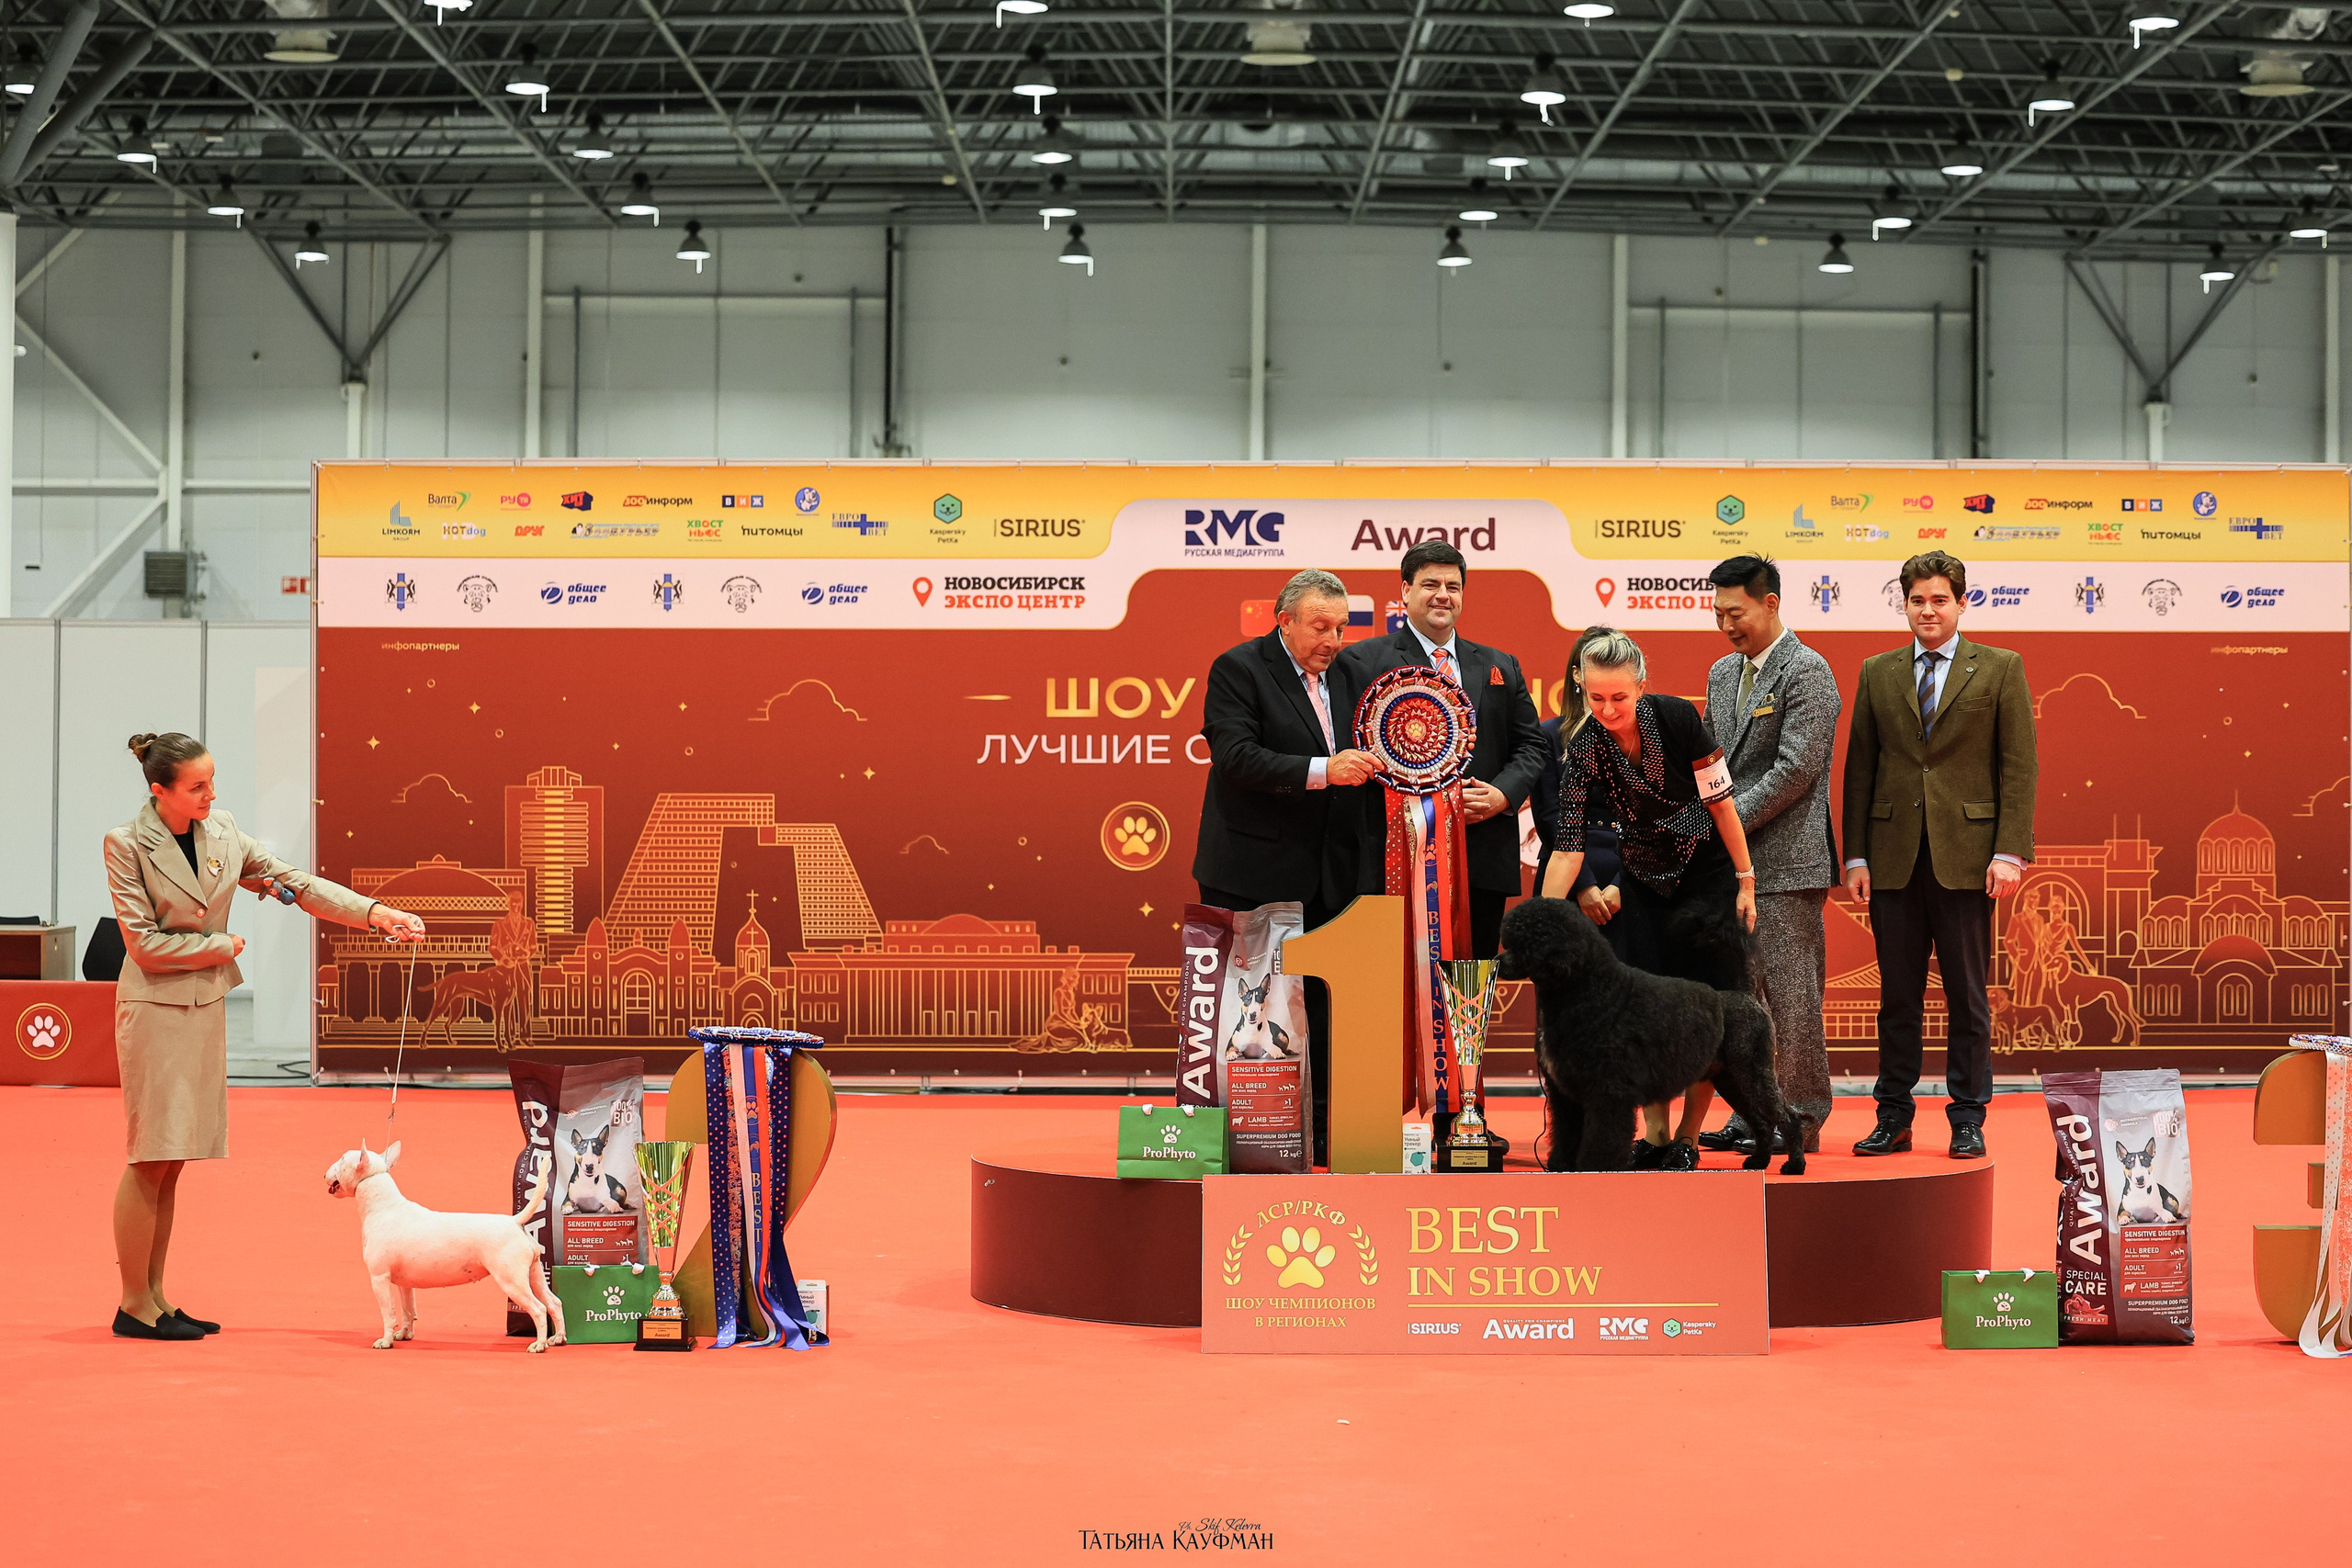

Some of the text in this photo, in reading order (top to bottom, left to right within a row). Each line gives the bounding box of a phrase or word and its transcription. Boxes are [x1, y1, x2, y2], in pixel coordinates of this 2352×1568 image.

[428, 493, 457, 504] Валта
[686, 520, 724, 528] ХВОСТ
[1184, 509, 1284, 547] RMG
[1351, 517, 1496, 551] Award
[1713, 529, 1748, 537] Kaspersky
[1184, 548, 1284, 558] РУССКАЯ МЕДИАГРУППА
[944, 577, 1086, 591] НОВОСИБИРСК
[1627, 578, 1714, 591] НОВОСИБ
[944, 594, 1086, 611] ЭКСПО ЦЕНТР
[1627, 596, 1696, 609] ЭКСПО
[381, 641, 460, 652] инфопартнеры
[1046, 676, 1197, 719] ШОУ
[976, 733, 1172, 765] ЛУЧШИЕ
[1707, 775, 1725, 791] 164
[1182, 960, 1191, 1008] CHAMPIONS
[1182, 946, 1220, 1100] Award
[1432, 1019, 1451, 1091] SHOW
[613, 1111, 633, 1124] BIO
[2157, 1122, 2178, 1135] BIO
[1142, 1145, 1197, 1162] ProPhyto
[2056, 1114, 2103, 1266] Award
[751, 1172, 763, 1243] BEST
[1256, 1199, 1347, 1229] ЛСР/РКФ
[1405, 1205, 1560, 1255] BEST
[1407, 1265, 1603, 1297] IN SHOW
[2065, 1269, 2108, 1281] SPECIAL
[2064, 1280, 2108, 1296] CARE
[1225, 1297, 1376, 1310] ШОУ ЧЕМПИОНОВ
[585, 1309, 642, 1325] ProPhyto
[1254, 1316, 1347, 1327] В РЕГИОНАХ
[1682, 1321, 1716, 1329] Kaspersky
[1974, 1314, 2031, 1331] ProPhyto
[2169, 1315, 2178, 1324] 12
[1481, 1317, 1575, 1340] Award
[1599, 1317, 1649, 1336] RMG
